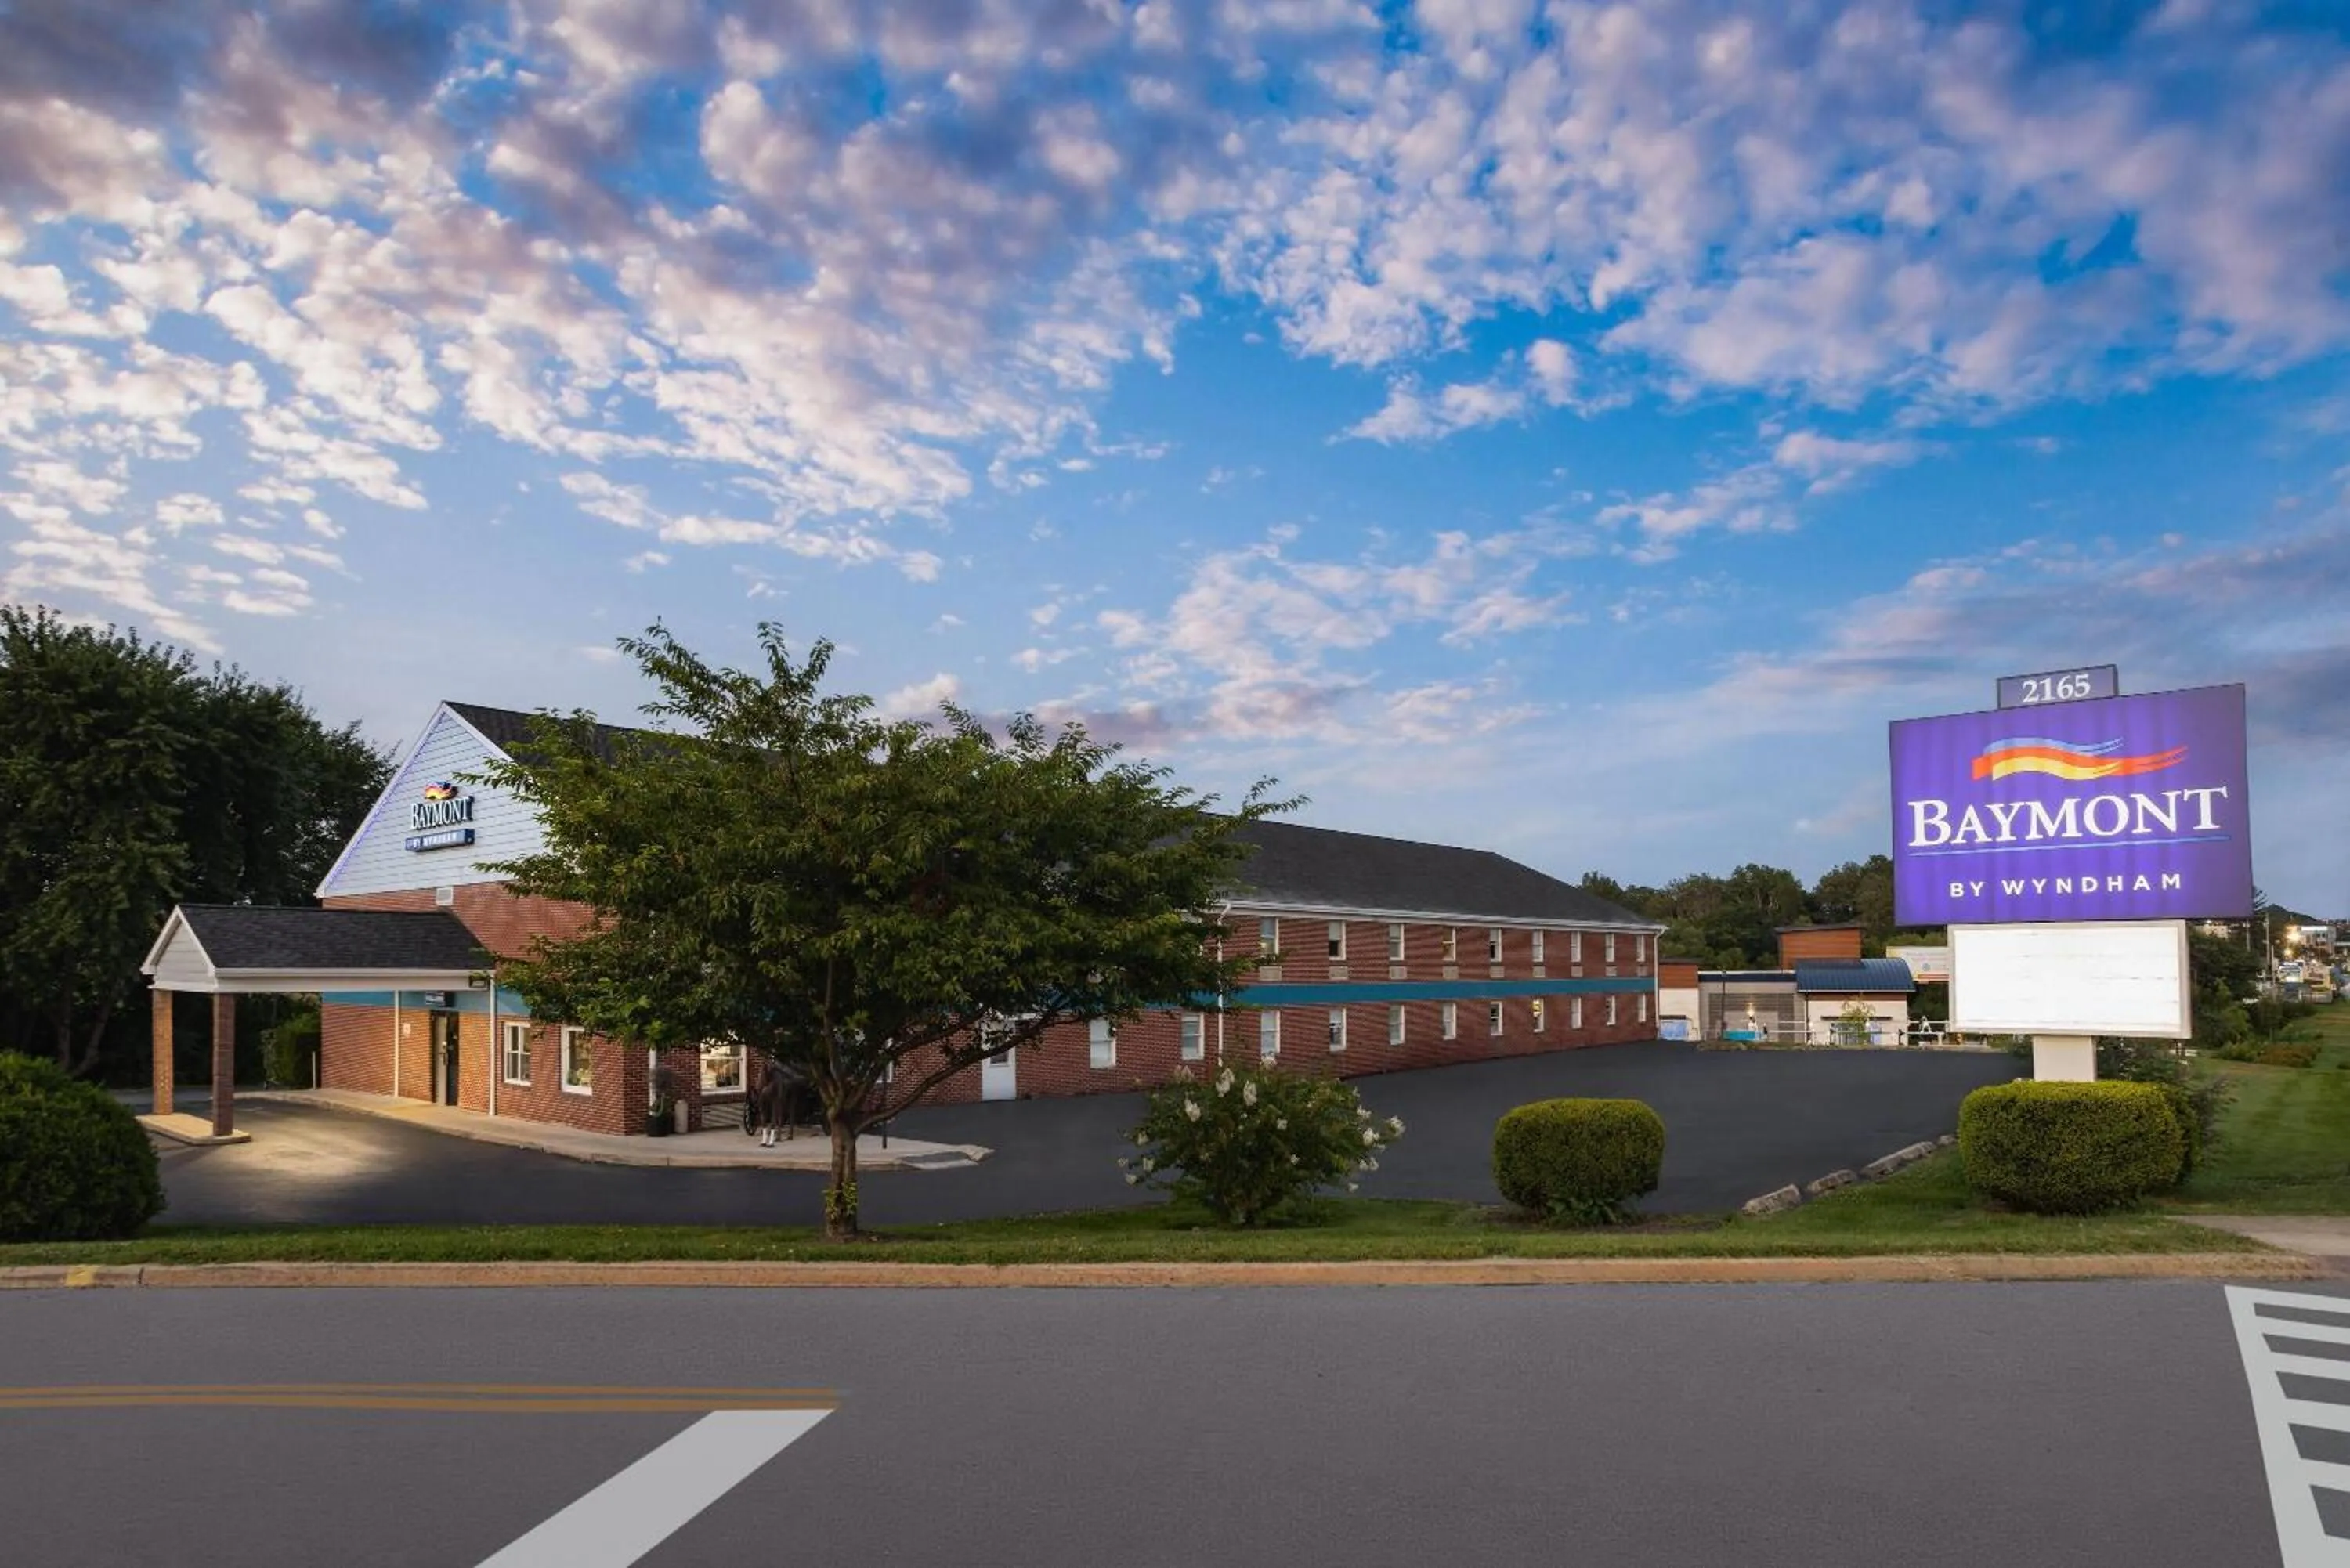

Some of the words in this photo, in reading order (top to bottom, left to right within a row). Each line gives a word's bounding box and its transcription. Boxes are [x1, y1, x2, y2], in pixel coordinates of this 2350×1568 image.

[2023, 674, 2091, 703] 2165
[411, 797, 470, 829] BAYMONT
[1908, 786, 2227, 847] BAYMONT
[1950, 882, 1984, 898] BY
[2001, 873, 2181, 895] WYNDHAM
